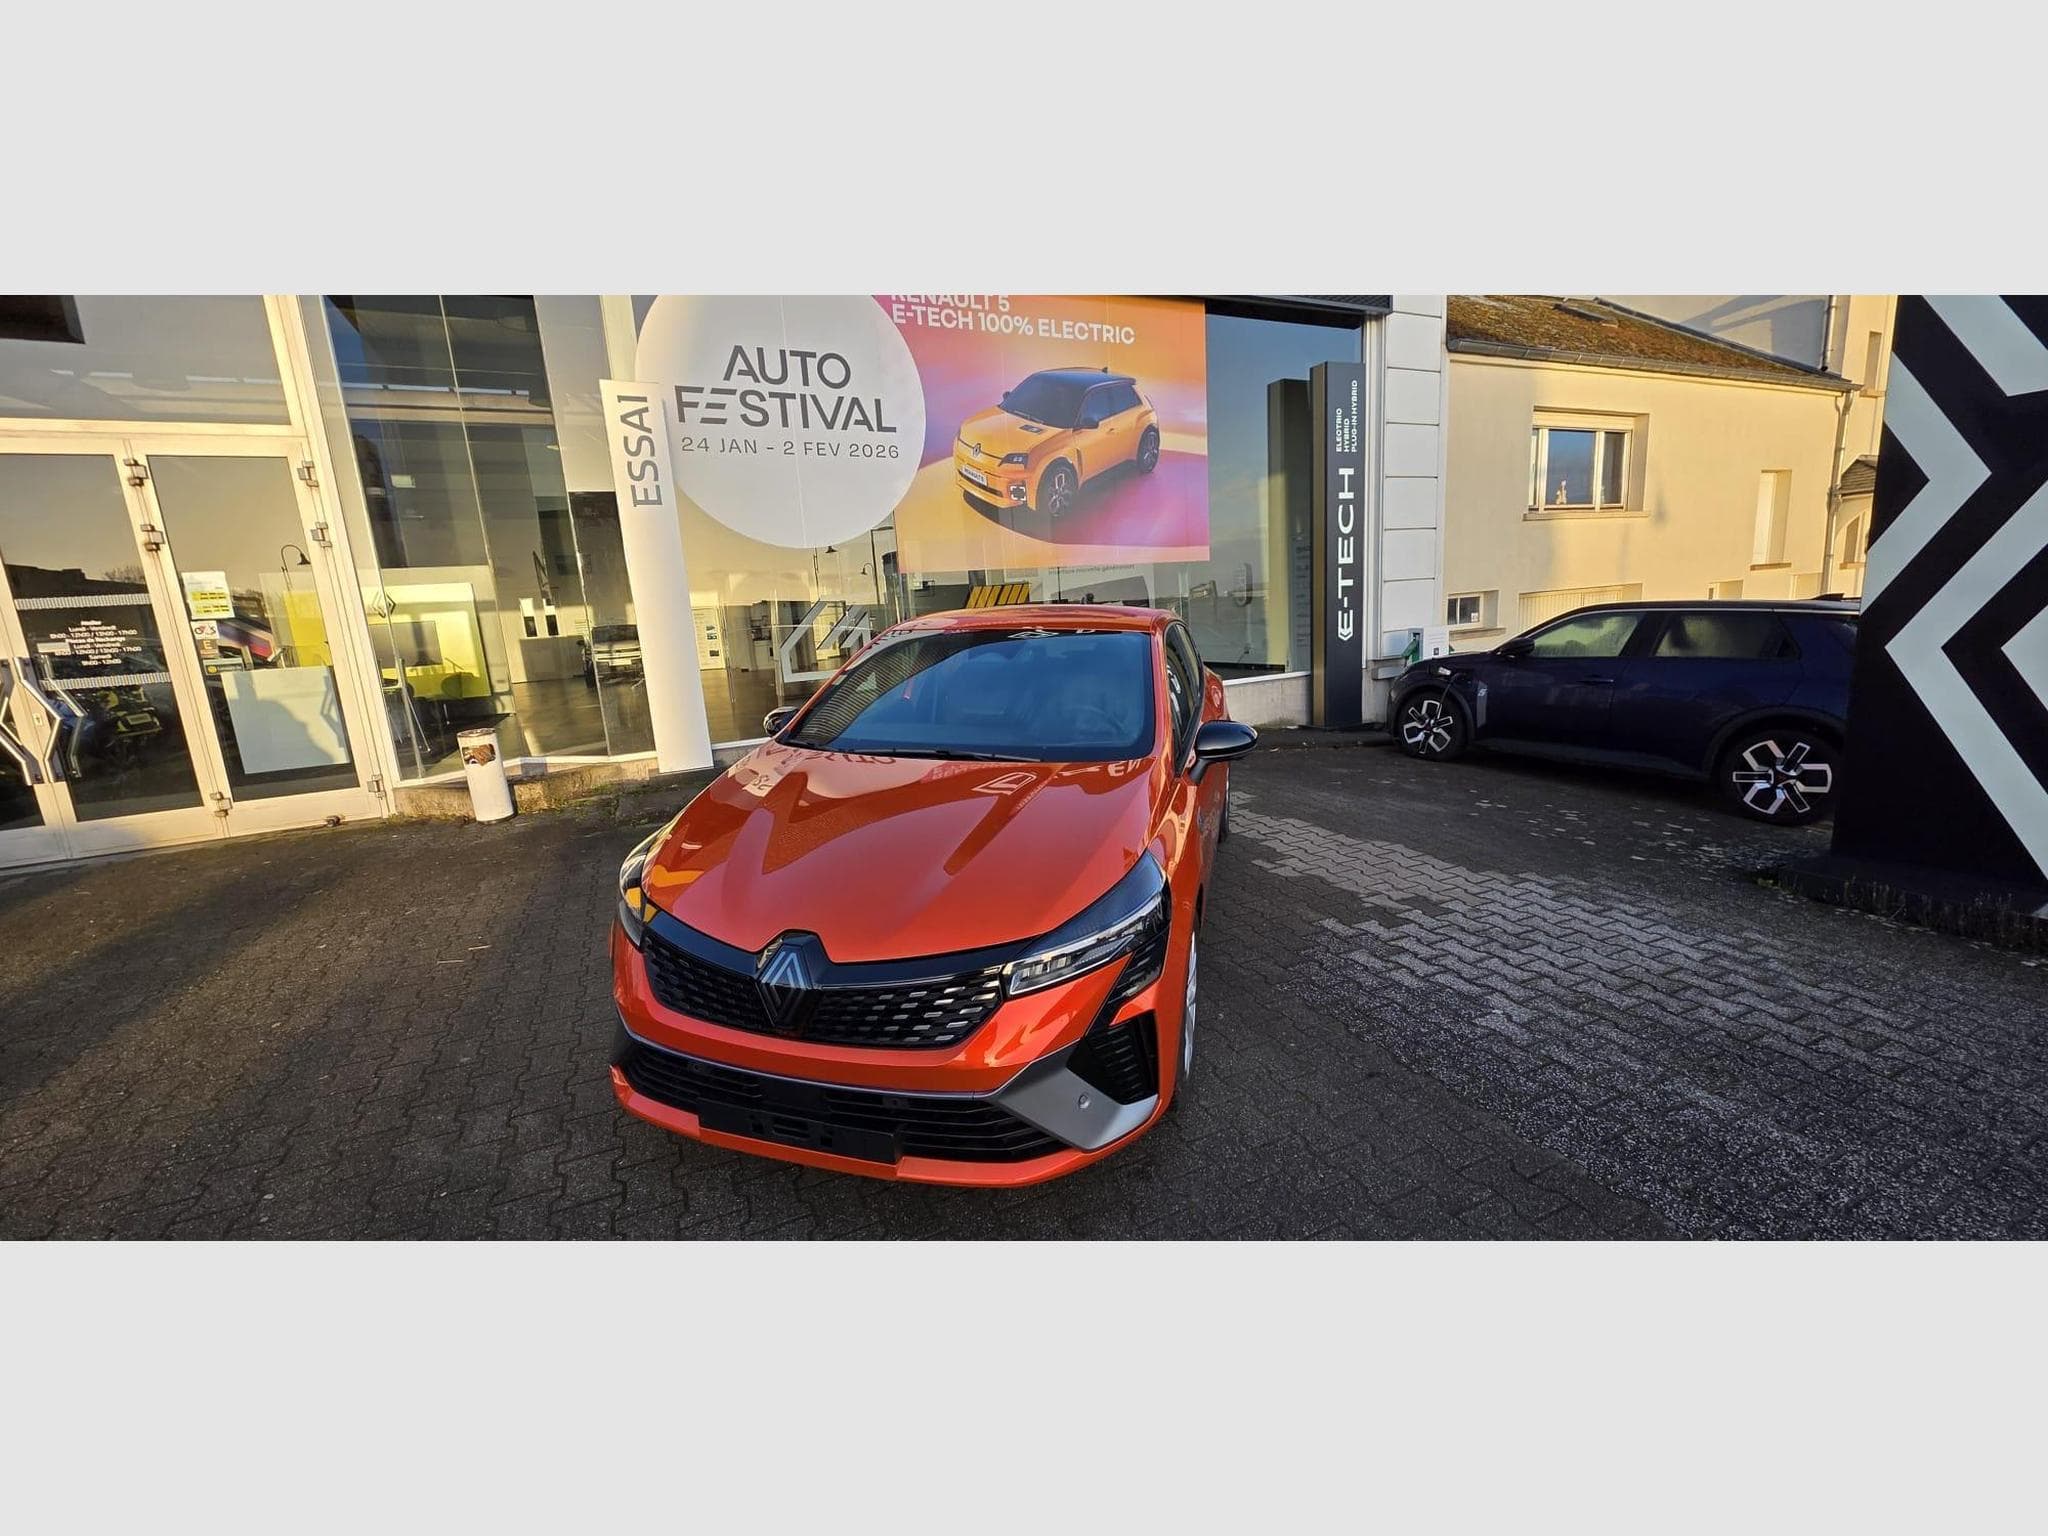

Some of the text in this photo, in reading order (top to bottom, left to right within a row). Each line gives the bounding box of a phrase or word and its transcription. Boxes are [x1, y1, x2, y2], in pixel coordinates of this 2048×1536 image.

[892, 303, 1136, 345] E-TECH 100% ELECTRIC
[998, 295, 1010, 313] 5
[722, 345, 851, 389] AUTO
[674, 385, 897, 433] FESTIVAL
[617, 395, 663, 507] ESSAI
[681, 436, 710, 452] 24
[720, 438, 757, 455] JAN
[783, 441, 795, 455] 2
[803, 441, 841, 457] FEV
[849, 443, 899, 459] 2026
[1338, 468, 1354, 641] E-TECH
